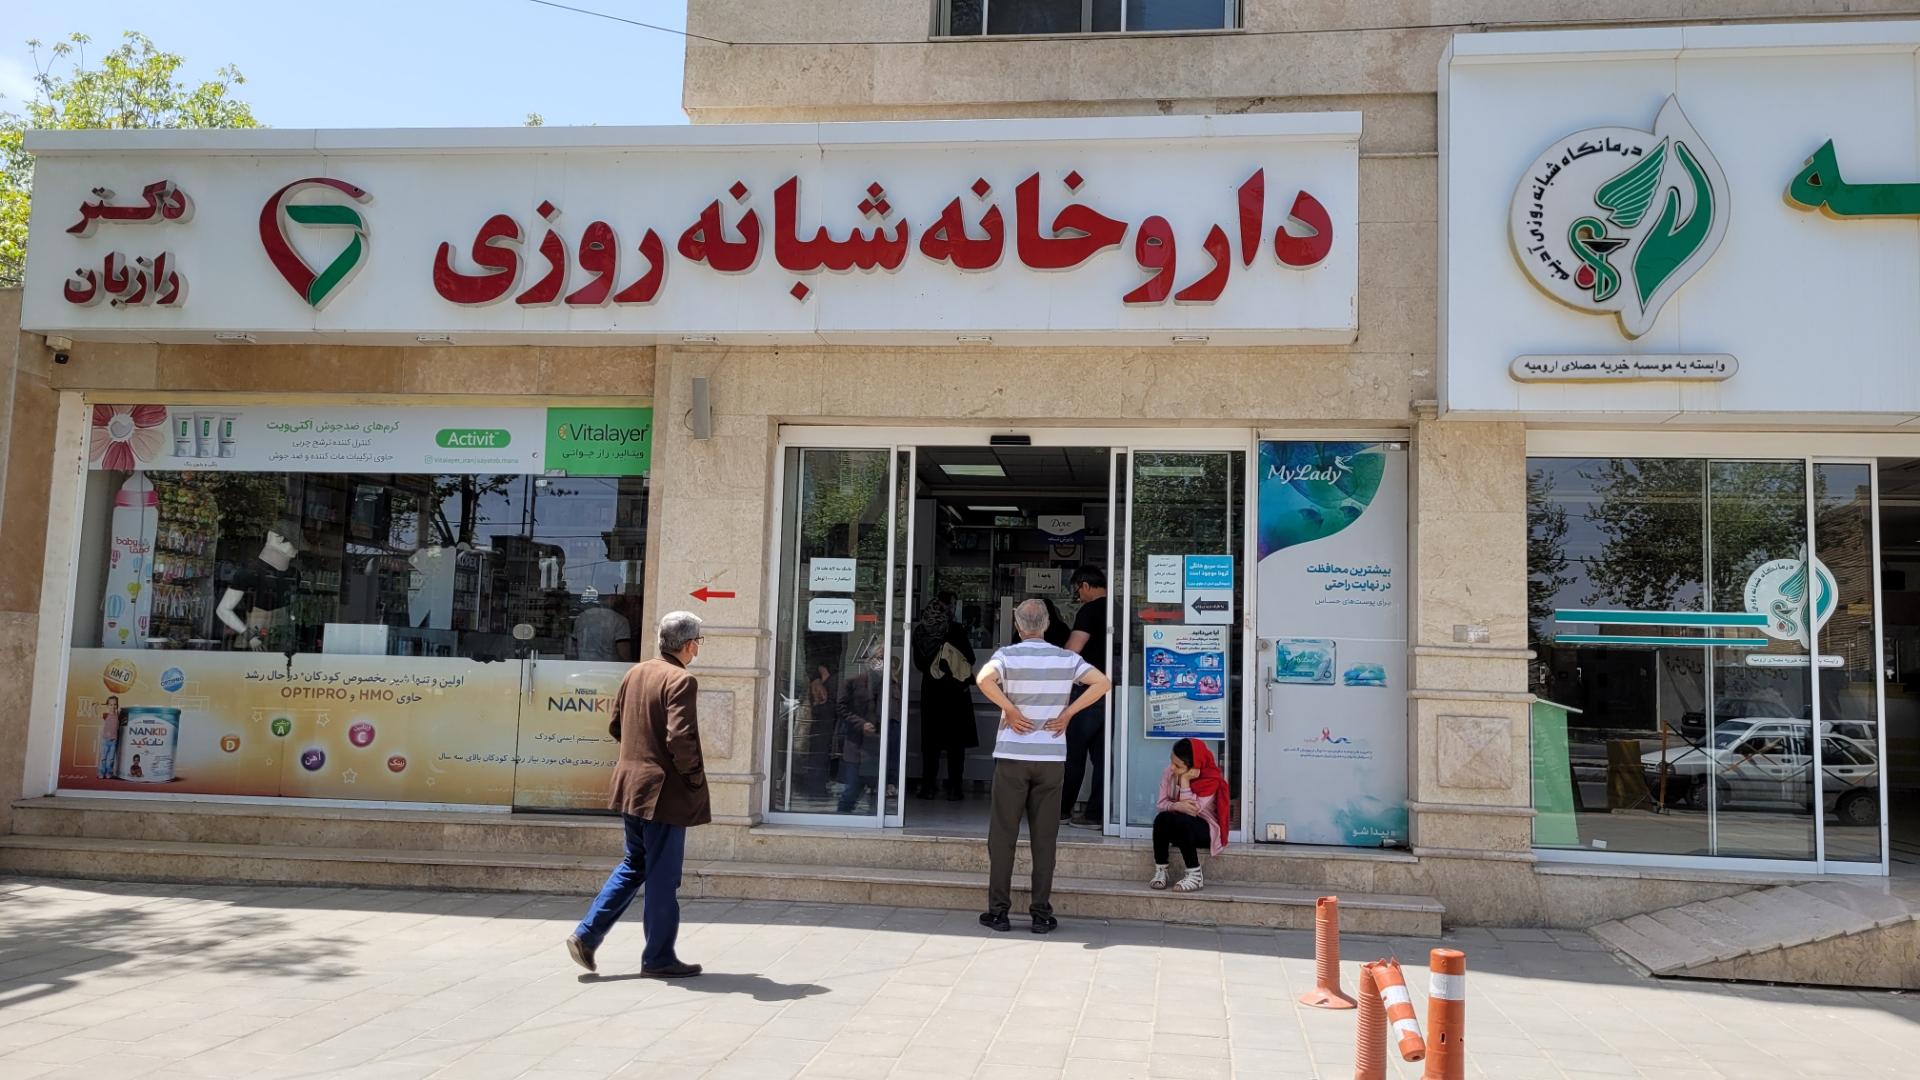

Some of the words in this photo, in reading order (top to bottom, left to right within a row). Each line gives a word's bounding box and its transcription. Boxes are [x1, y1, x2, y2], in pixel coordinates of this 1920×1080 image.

[1561, 137, 1642, 167] درمانگاه
[1532, 162, 1561, 201] شبانه
[65, 179, 195, 238] دکتر
[677, 174, 908, 302] شبانه
[919, 168, 1334, 307] داروخانه
[431, 200, 667, 307] روزی
[1527, 245, 1570, 281] آدینه
[1524, 360, 1558, 373] ارومیه
[1561, 360, 1597, 372] مصلای
[1600, 359, 1630, 375] خیریه
[1633, 360, 1672, 372] موسسه
[1675, 360, 1688, 374] به
[1690, 359, 1725, 374] وابسته
[447, 431, 495, 446] Activit
[568, 424, 646, 446] Vitalayer
[1306, 562, 1348, 574] محافظت
[1349, 564, 1391, 578] بیشترین
[1325, 578, 1350, 591] راحتی
[1351, 579, 1379, 592] نهایت
[1380, 582, 1391, 592] در
[244, 670, 266, 682] رشد
[343, 673, 387, 686] مخصوص
[412, 673, 430, 687] تنها
[431, 678, 437, 687] و
[438, 675, 465, 689] اولین
[280, 686, 348, 700] OPTIPRO
[349, 693, 355, 703] و
[359, 689, 394, 701] HMO
[396, 692, 423, 705] حاوی
[128, 727, 168, 736] NANKID
[277, 726, 285, 735] A
[226, 740, 236, 751] D
